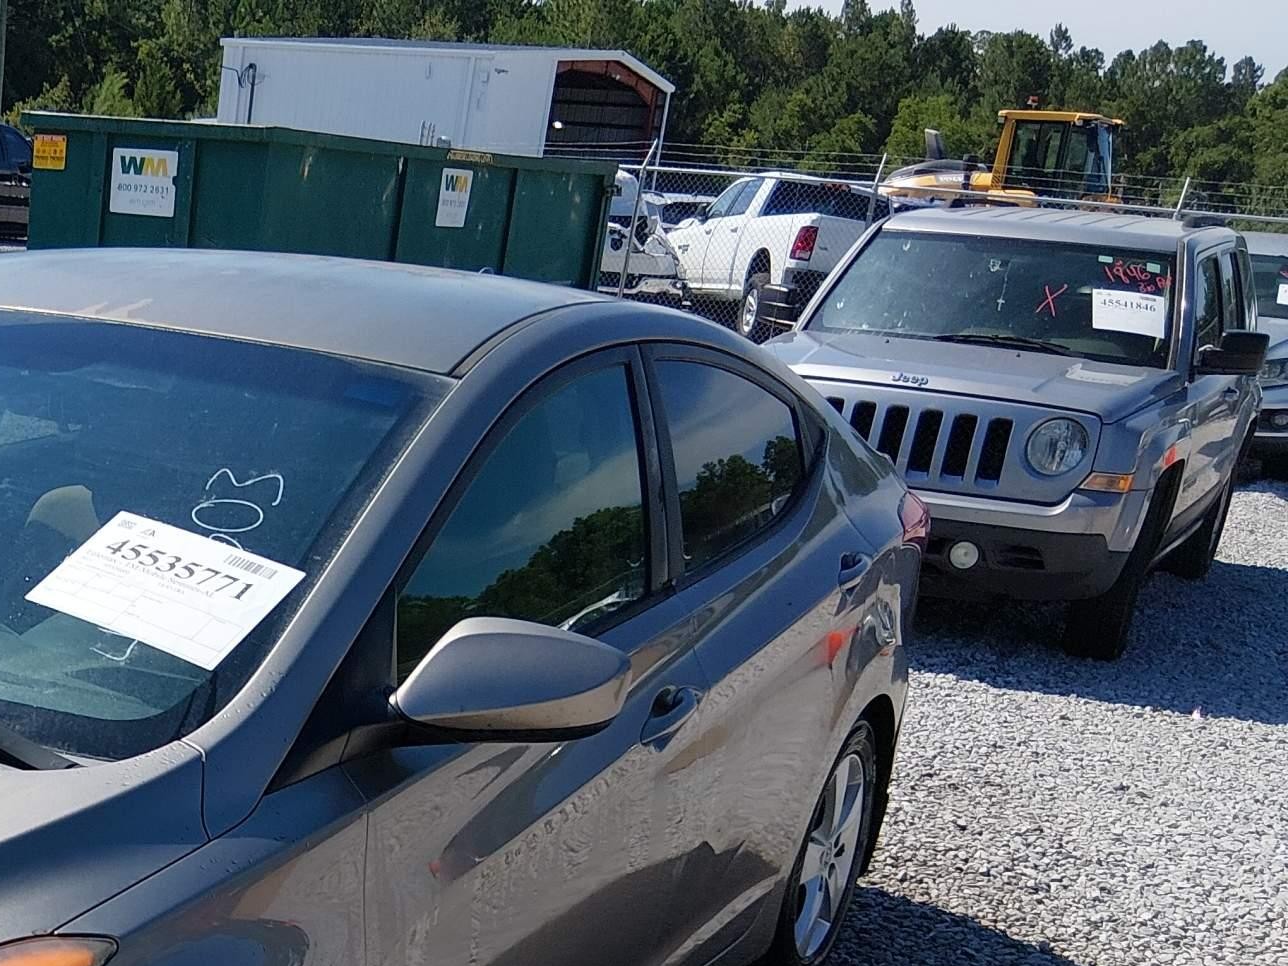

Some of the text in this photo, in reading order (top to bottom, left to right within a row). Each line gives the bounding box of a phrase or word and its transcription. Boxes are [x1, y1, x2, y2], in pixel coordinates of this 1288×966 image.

[120, 156, 168, 176] WM
[446, 174, 468, 192] WM
[1101, 299, 1157, 312] 45541846
[892, 372, 929, 387] Jeep
[106, 539, 253, 601] 45535771
